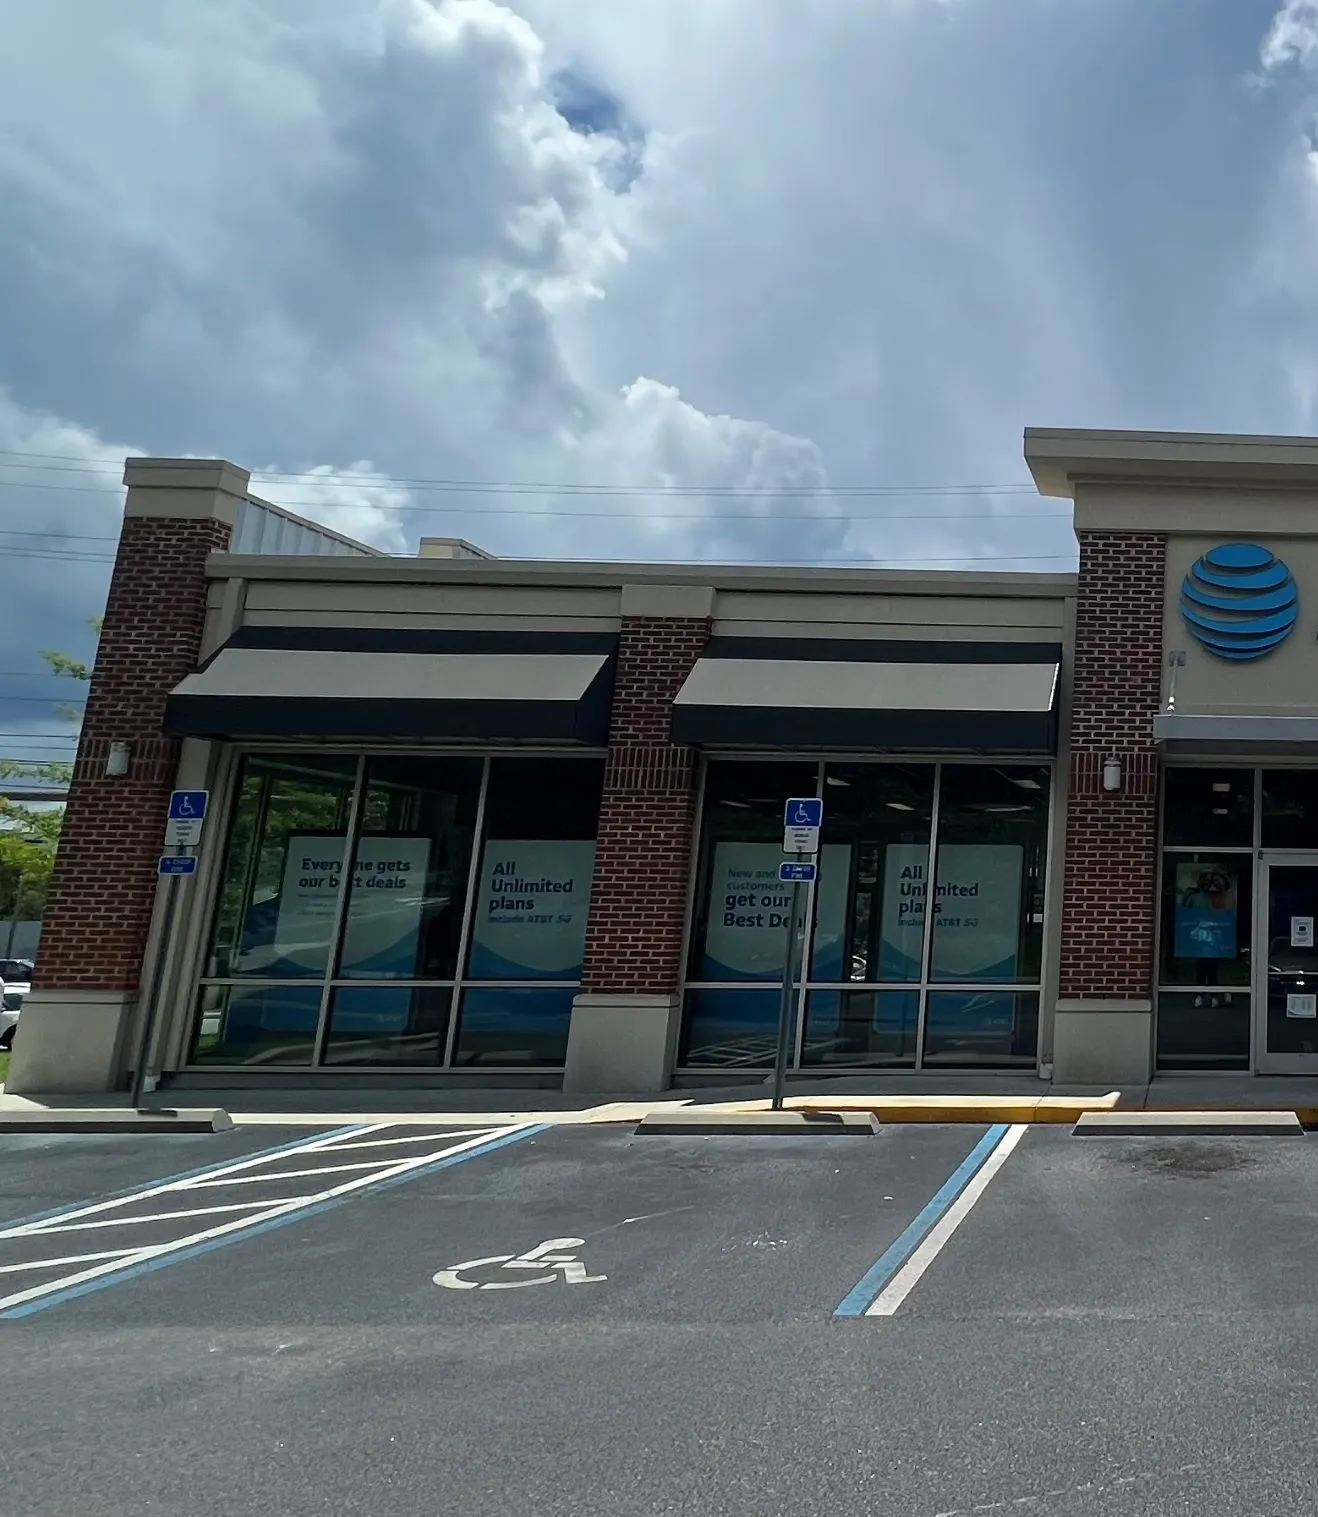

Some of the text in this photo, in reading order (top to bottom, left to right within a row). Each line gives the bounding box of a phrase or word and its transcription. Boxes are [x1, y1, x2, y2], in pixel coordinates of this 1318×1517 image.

[302, 858, 411, 874] Everyne gets
[493, 861, 516, 876] All
[728, 868, 753, 878] New
[755, 869, 776, 878] and
[900, 865, 922, 879] All
[299, 877, 325, 888] our
[366, 875, 407, 889] deals
[491, 878, 574, 893] Unlimited
[726, 882, 785, 891] customers
[900, 882, 979, 896] Unlmited
[489, 896, 535, 914] plans
[725, 893, 792, 911] get our
[898, 899, 942, 916] plas
[723, 912, 764, 927] Best
